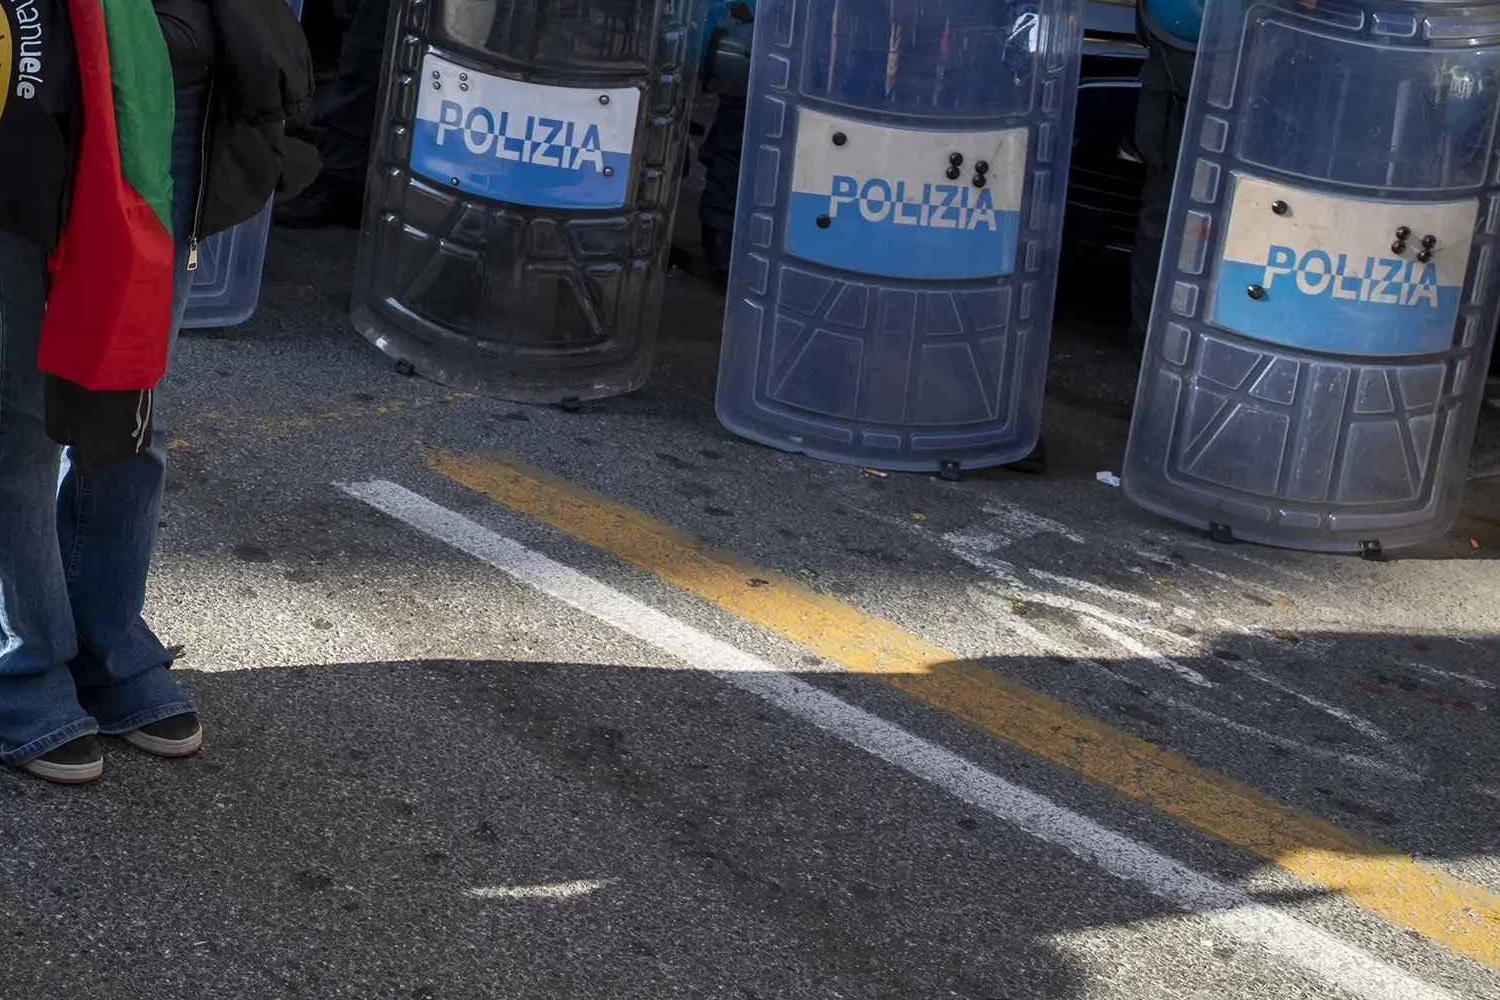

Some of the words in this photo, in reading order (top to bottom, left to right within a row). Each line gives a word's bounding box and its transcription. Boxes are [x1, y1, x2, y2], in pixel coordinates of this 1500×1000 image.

[436, 99, 604, 173] POLIZIA
[829, 174, 997, 232] POLIZIA
[1262, 244, 1438, 308] POLIZIA
